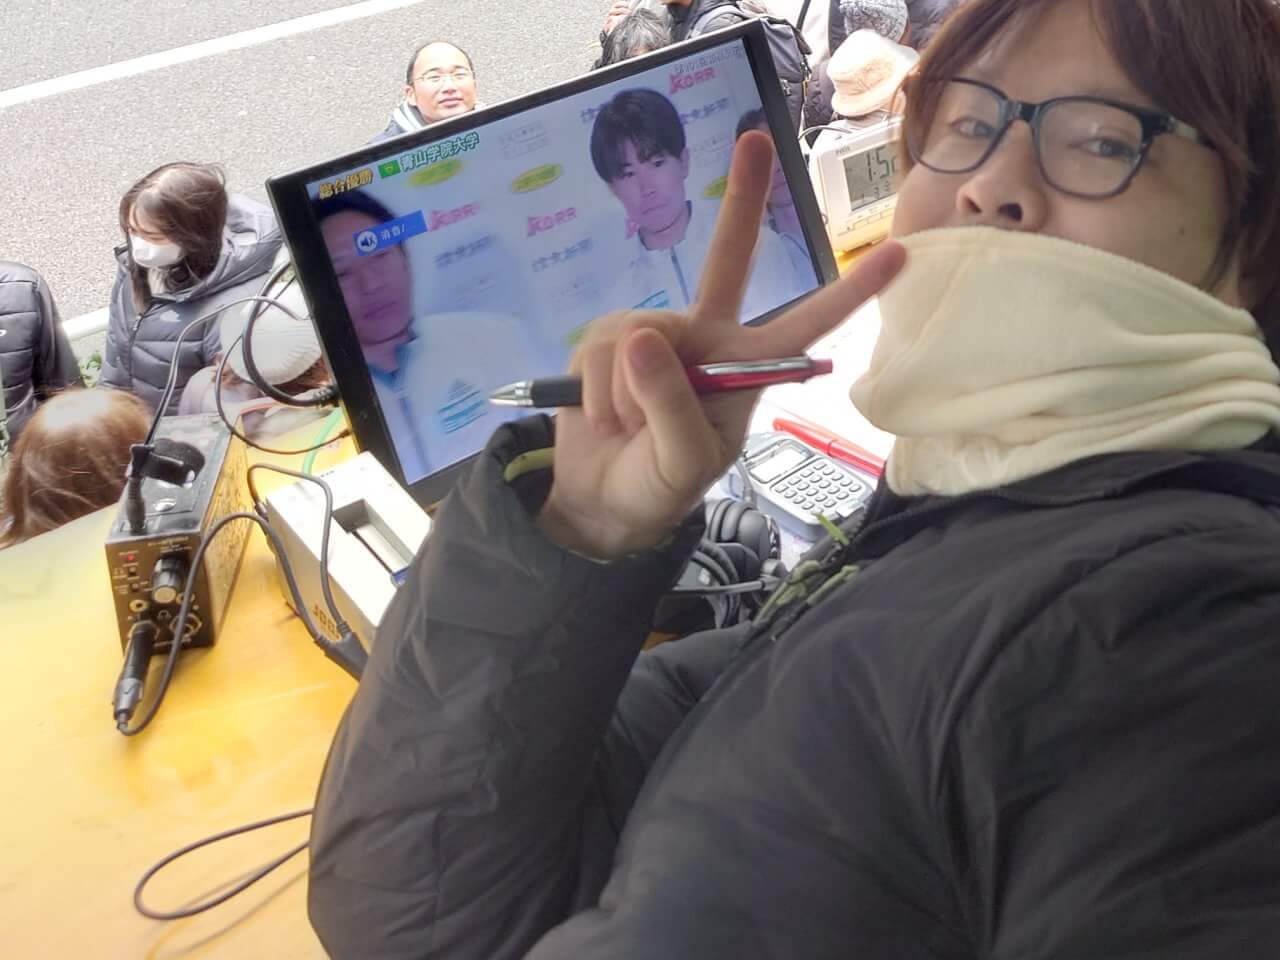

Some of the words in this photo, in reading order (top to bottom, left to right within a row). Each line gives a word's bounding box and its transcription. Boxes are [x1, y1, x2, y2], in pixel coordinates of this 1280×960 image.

[400, 131, 480, 172] 青山学院大学
[318, 167, 374, 201] 総合優勝
